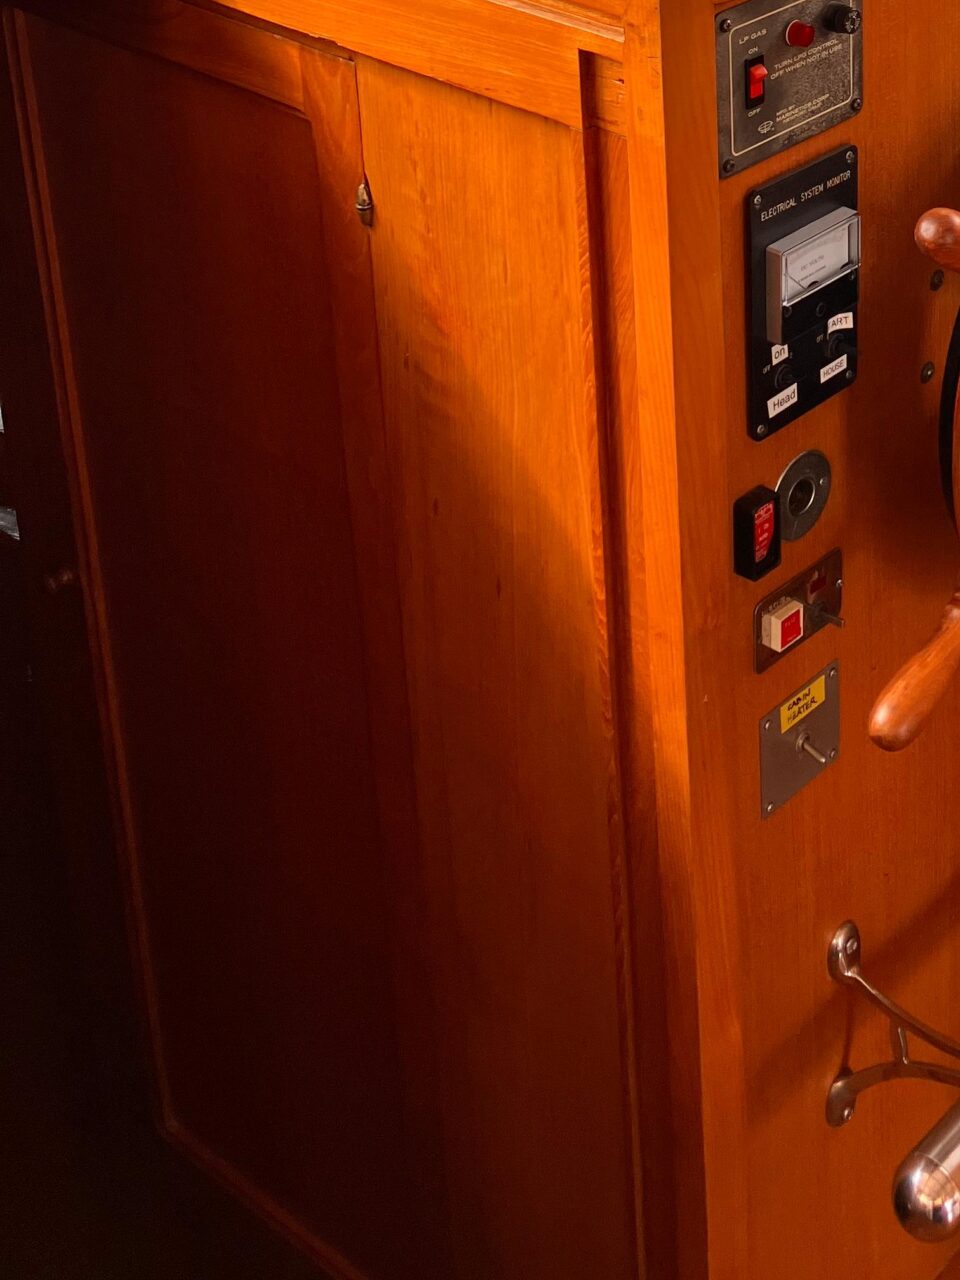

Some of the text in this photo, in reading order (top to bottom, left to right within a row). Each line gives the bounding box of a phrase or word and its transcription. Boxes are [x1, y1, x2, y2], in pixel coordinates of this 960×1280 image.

[739, 28, 767, 45] LP GAS
[748, 46, 759, 55] ON
[774, 58, 793, 70] TURN
[807, 39, 840, 55] CONTROL
[770, 69, 785, 80] OFF
[785, 60, 806, 73] WHEN
[806, 53, 821, 64] NOT
[747, 107, 761, 118] OFF
[761, 169, 851, 221] ELECTRICAL SYSTEM MONITOR
[774, 347, 786, 360] on
[823, 359, 845, 379] HOUSE
[773, 387, 796, 411] Head
[787, 687, 811, 711] CABIN
[787, 695, 817, 725] HEATER
